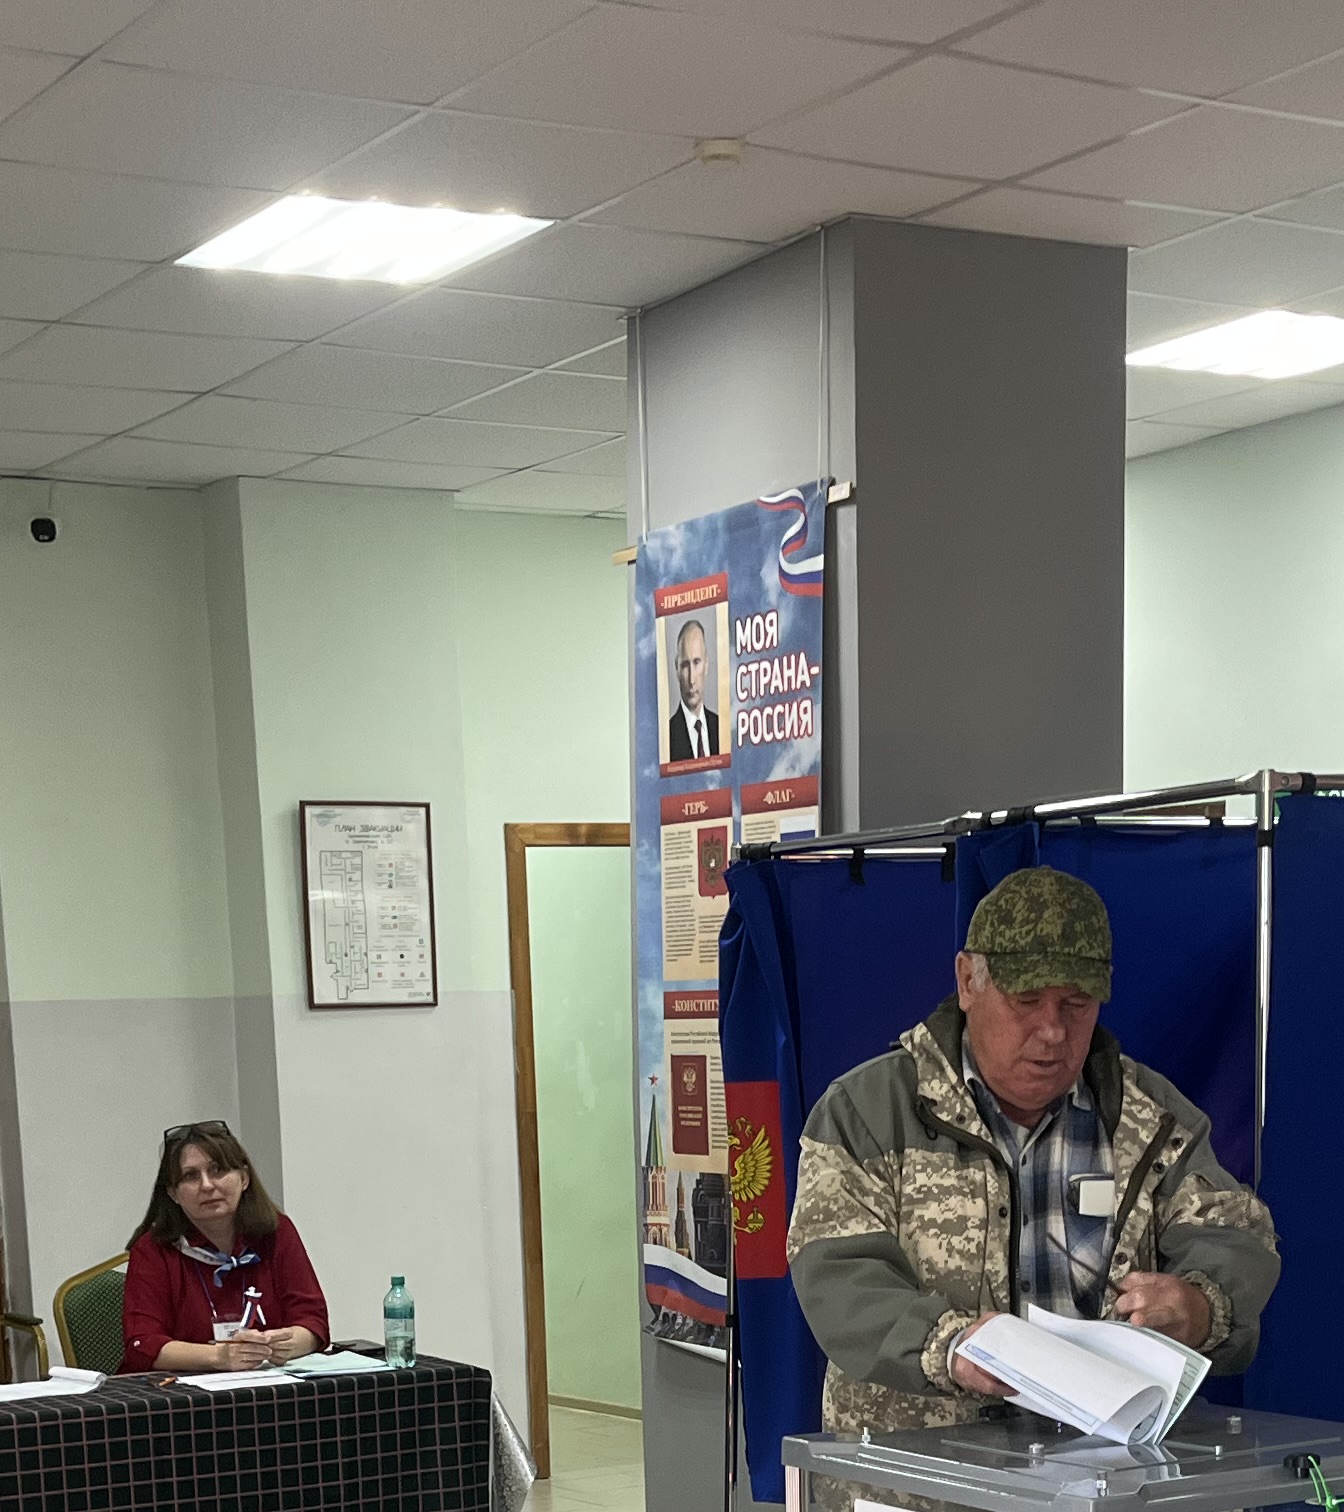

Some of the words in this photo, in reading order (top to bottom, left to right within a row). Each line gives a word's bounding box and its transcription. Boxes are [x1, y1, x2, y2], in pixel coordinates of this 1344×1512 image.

[735, 609, 779, 655] МОЯ
[735, 653, 820, 701] СТРАНА-
[737, 699, 814, 747] РОССИЯ
[674, 999, 719, 1012] КОНСТИТ
